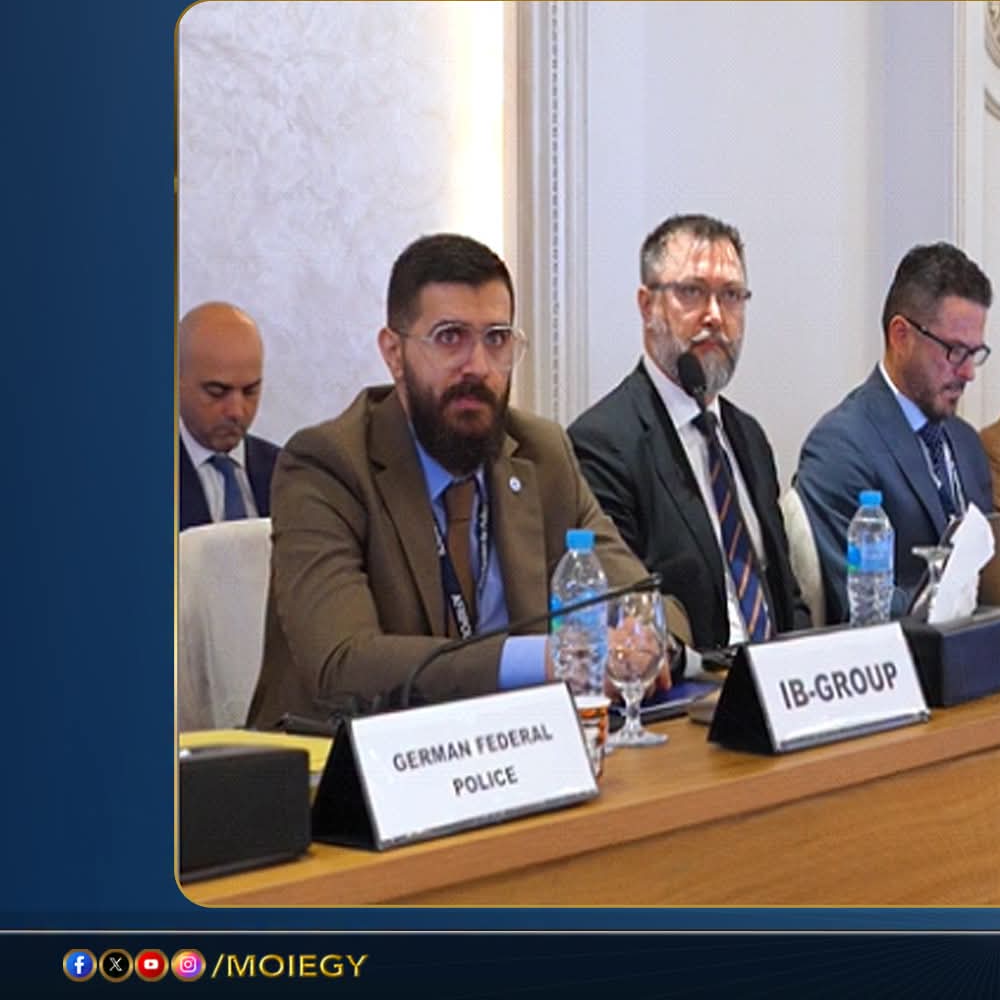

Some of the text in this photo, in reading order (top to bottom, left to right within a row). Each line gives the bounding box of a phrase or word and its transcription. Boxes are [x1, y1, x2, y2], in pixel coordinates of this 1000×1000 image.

[780, 662, 897, 710] IB-GROUP
[393, 724, 553, 772] GERMAN FEDERAL
[452, 766, 518, 796] POLICE
